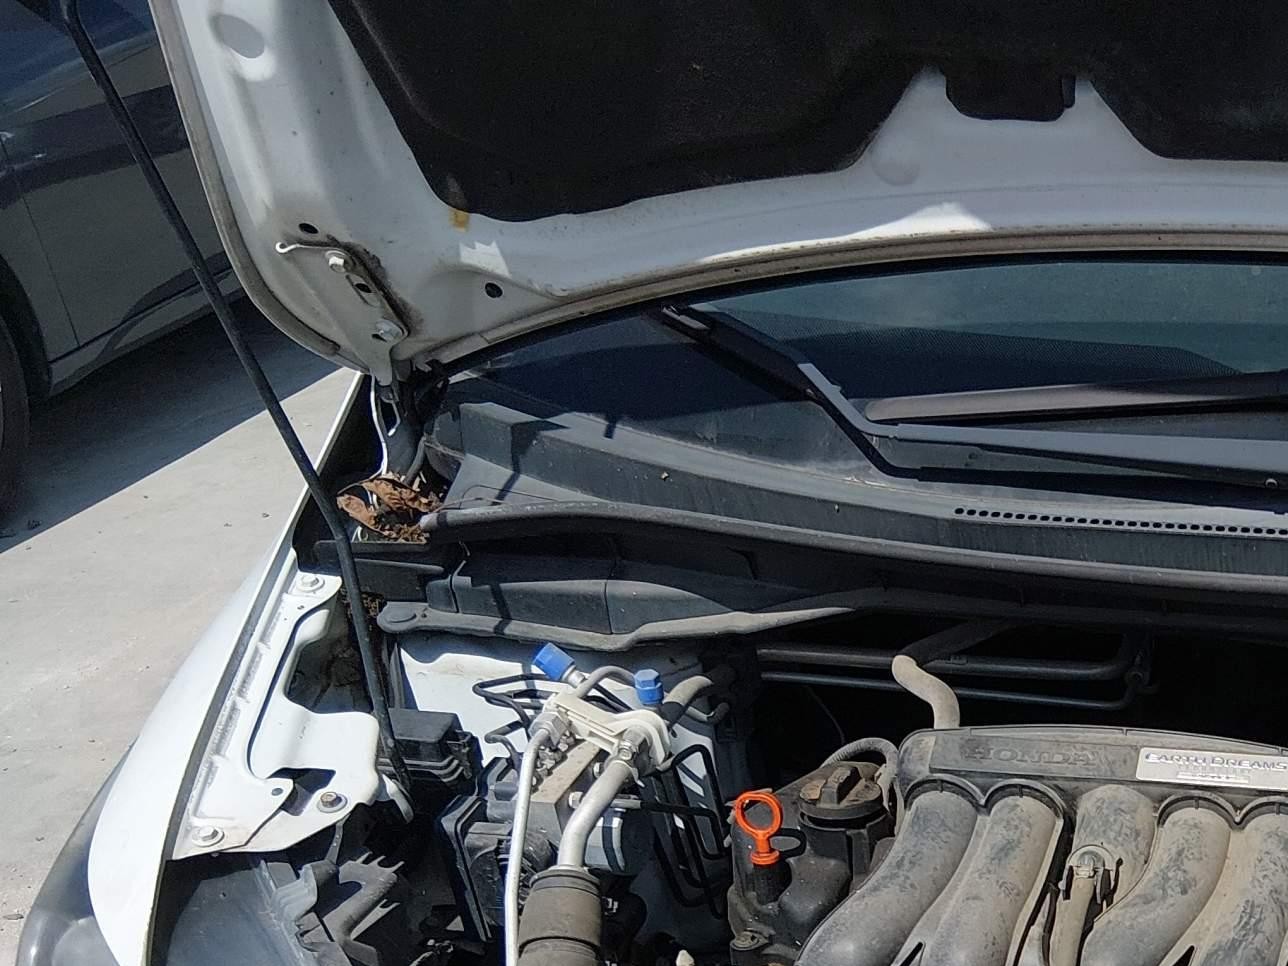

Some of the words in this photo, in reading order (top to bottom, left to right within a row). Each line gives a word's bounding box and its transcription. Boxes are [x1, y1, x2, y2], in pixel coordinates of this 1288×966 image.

[962, 744, 1098, 767] HONDA
[1144, 752, 1206, 768] EARTH
[1211, 756, 1288, 773] DREAMS
